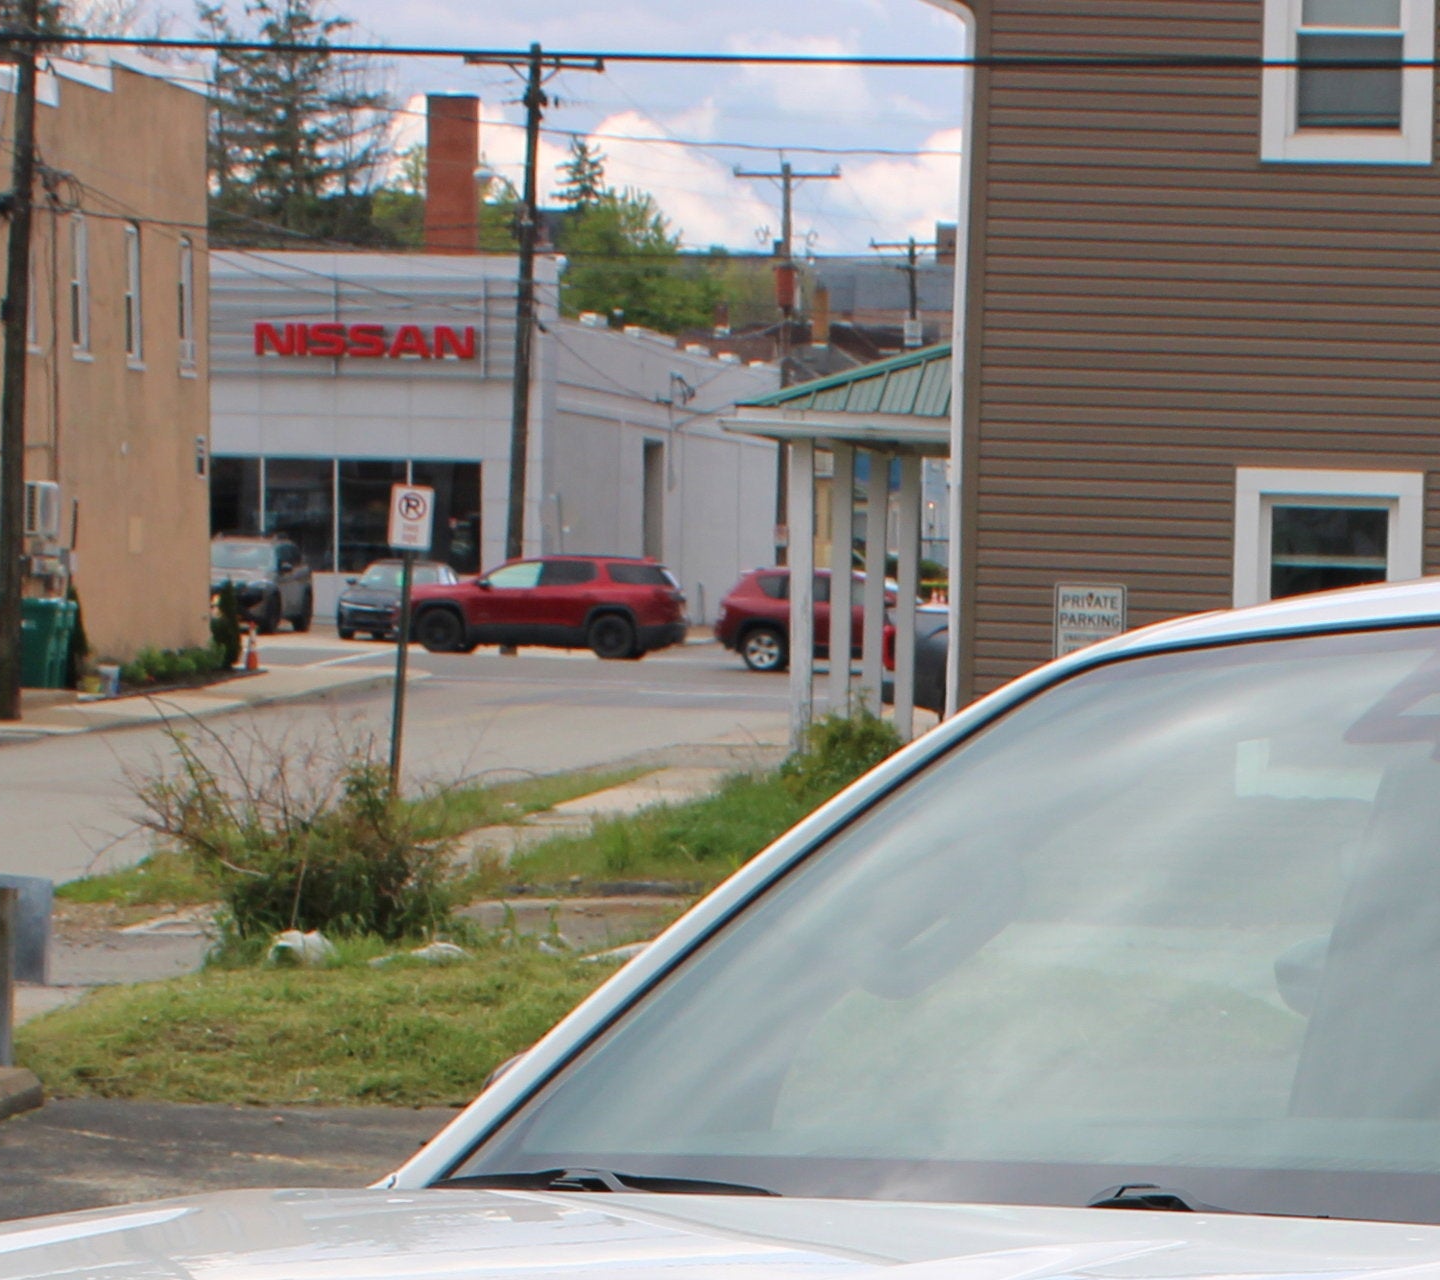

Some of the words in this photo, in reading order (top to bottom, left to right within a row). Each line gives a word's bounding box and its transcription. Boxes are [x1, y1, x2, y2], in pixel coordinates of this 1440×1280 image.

[254, 322, 475, 358] NISSAN
[1061, 594, 1119, 609] PRIVATE
[1059, 612, 1120, 627] PARKING
